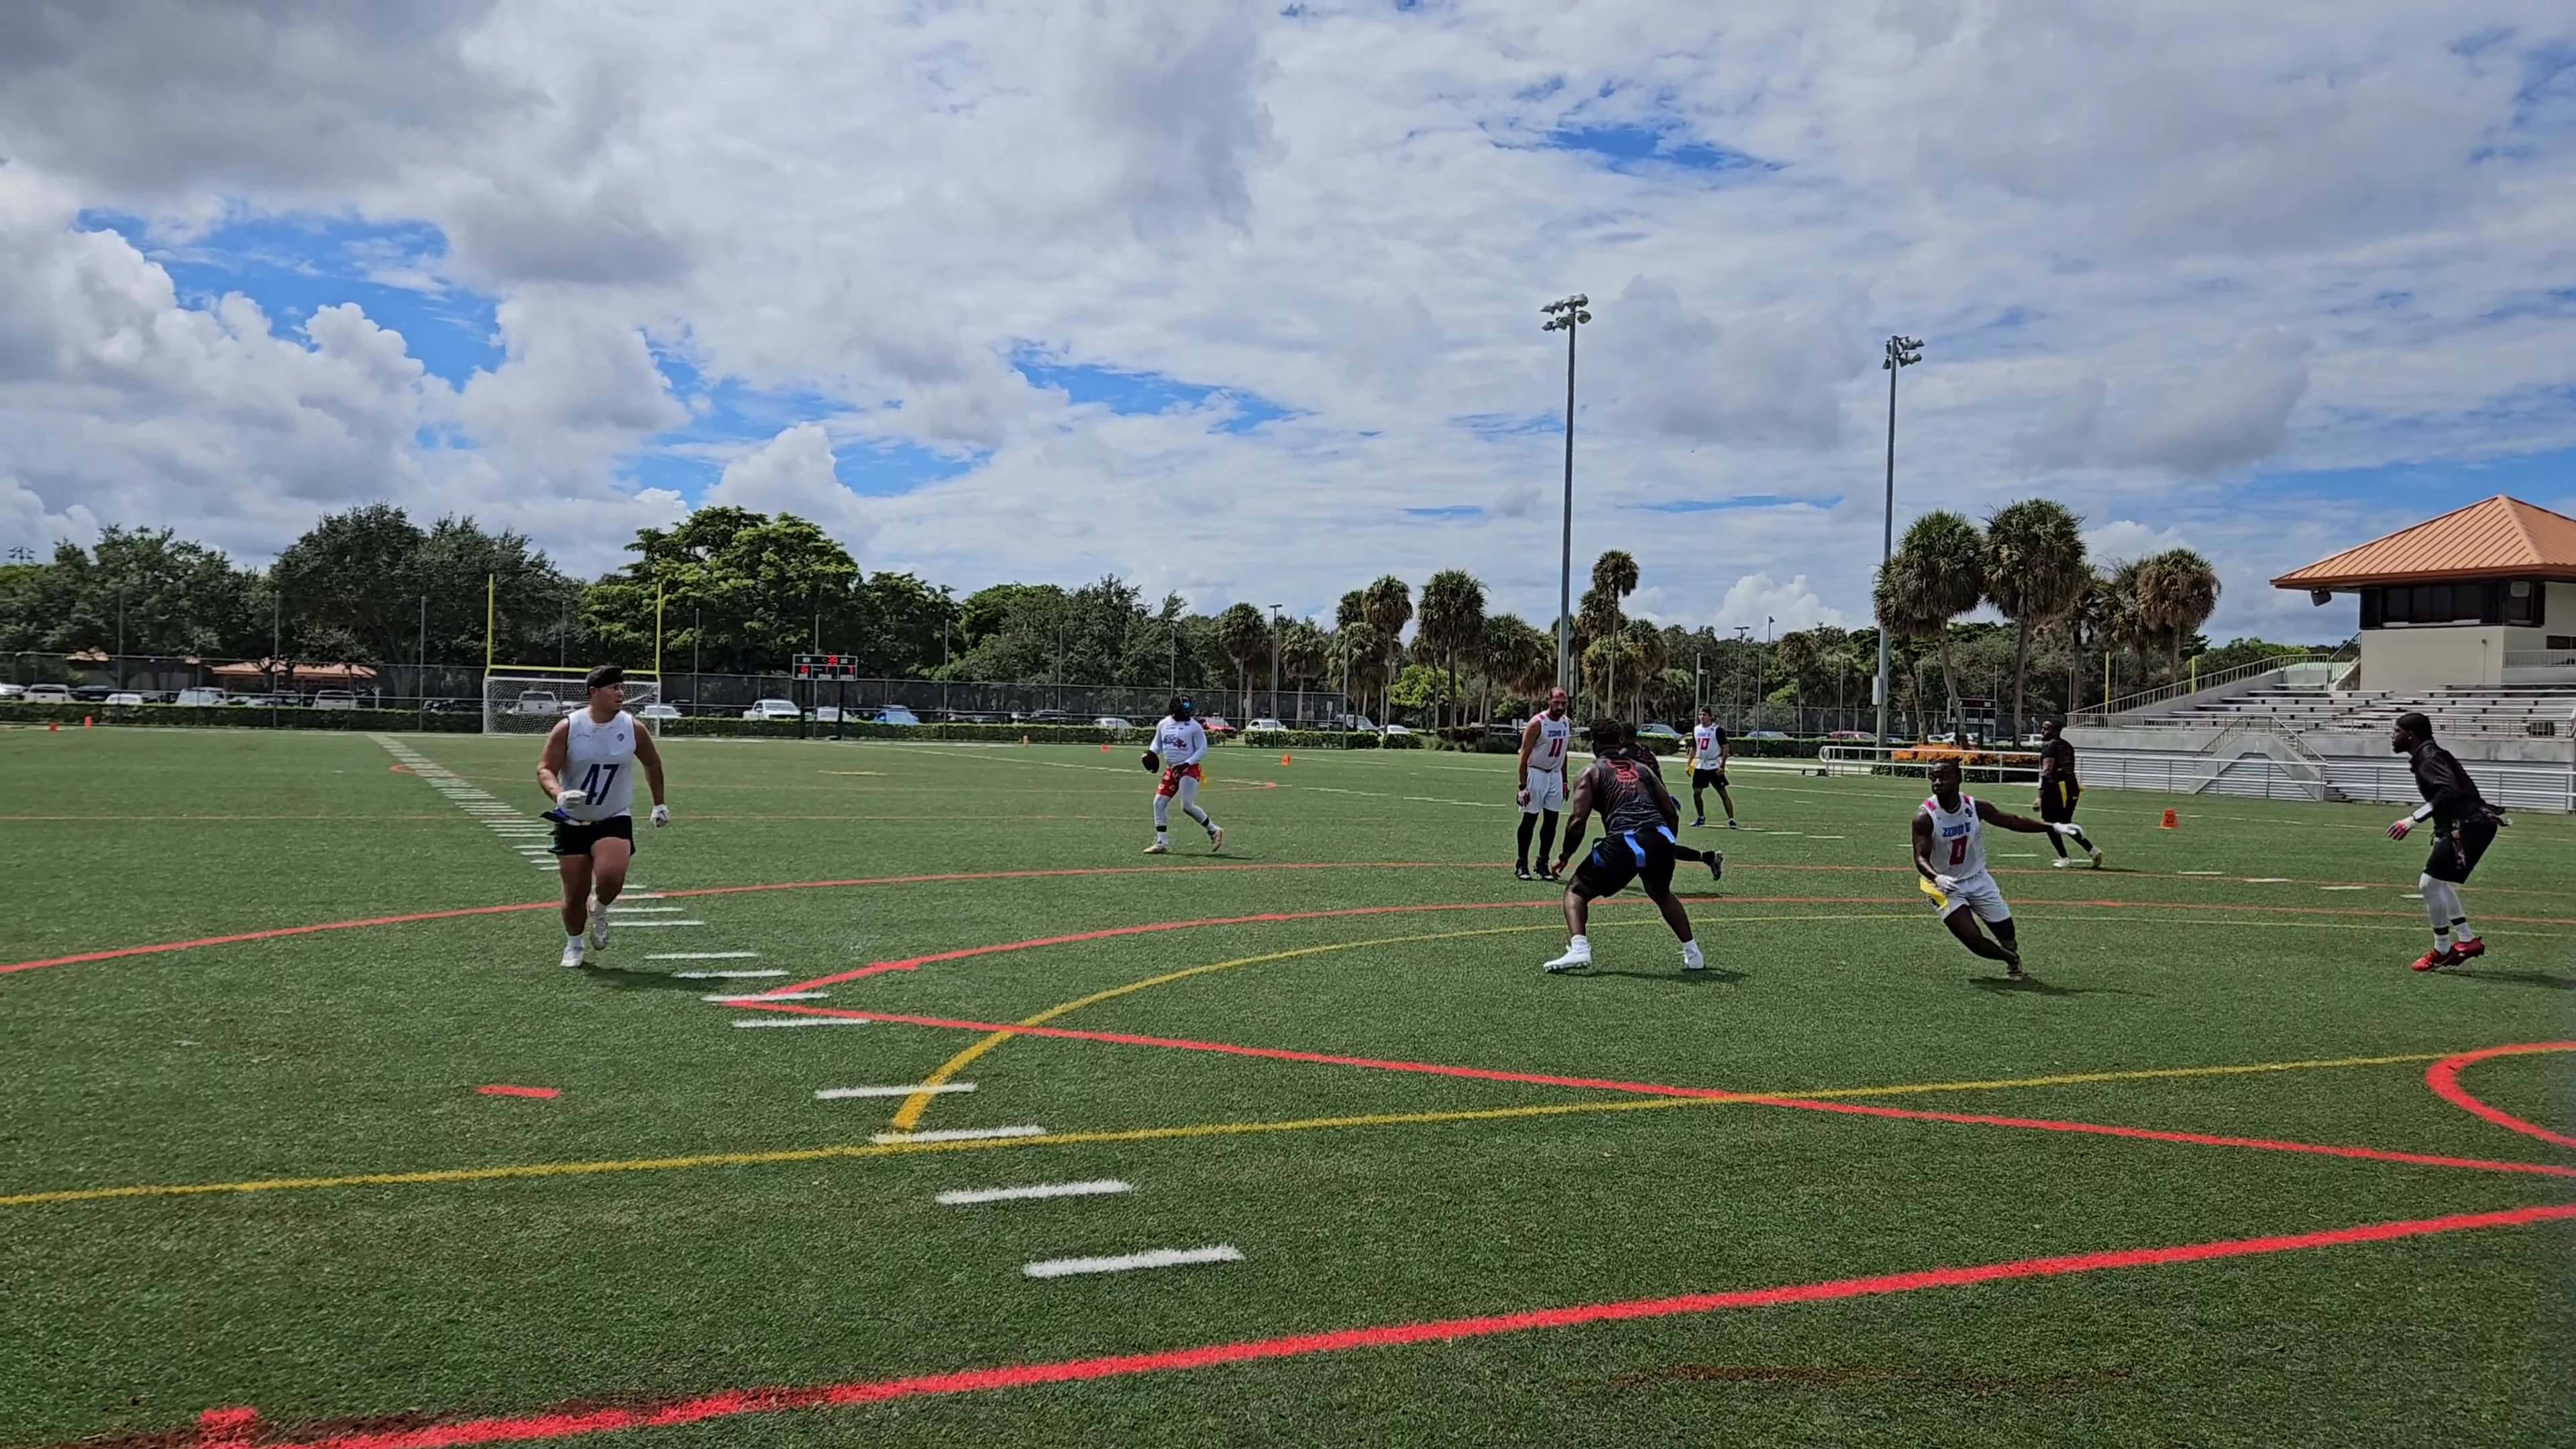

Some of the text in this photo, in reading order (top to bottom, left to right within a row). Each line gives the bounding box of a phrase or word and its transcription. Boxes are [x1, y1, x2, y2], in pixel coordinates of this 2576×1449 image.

[1548, 738, 1563, 757] 11
[1698, 738, 1710, 750] 10
[580, 763, 619, 806] 47
